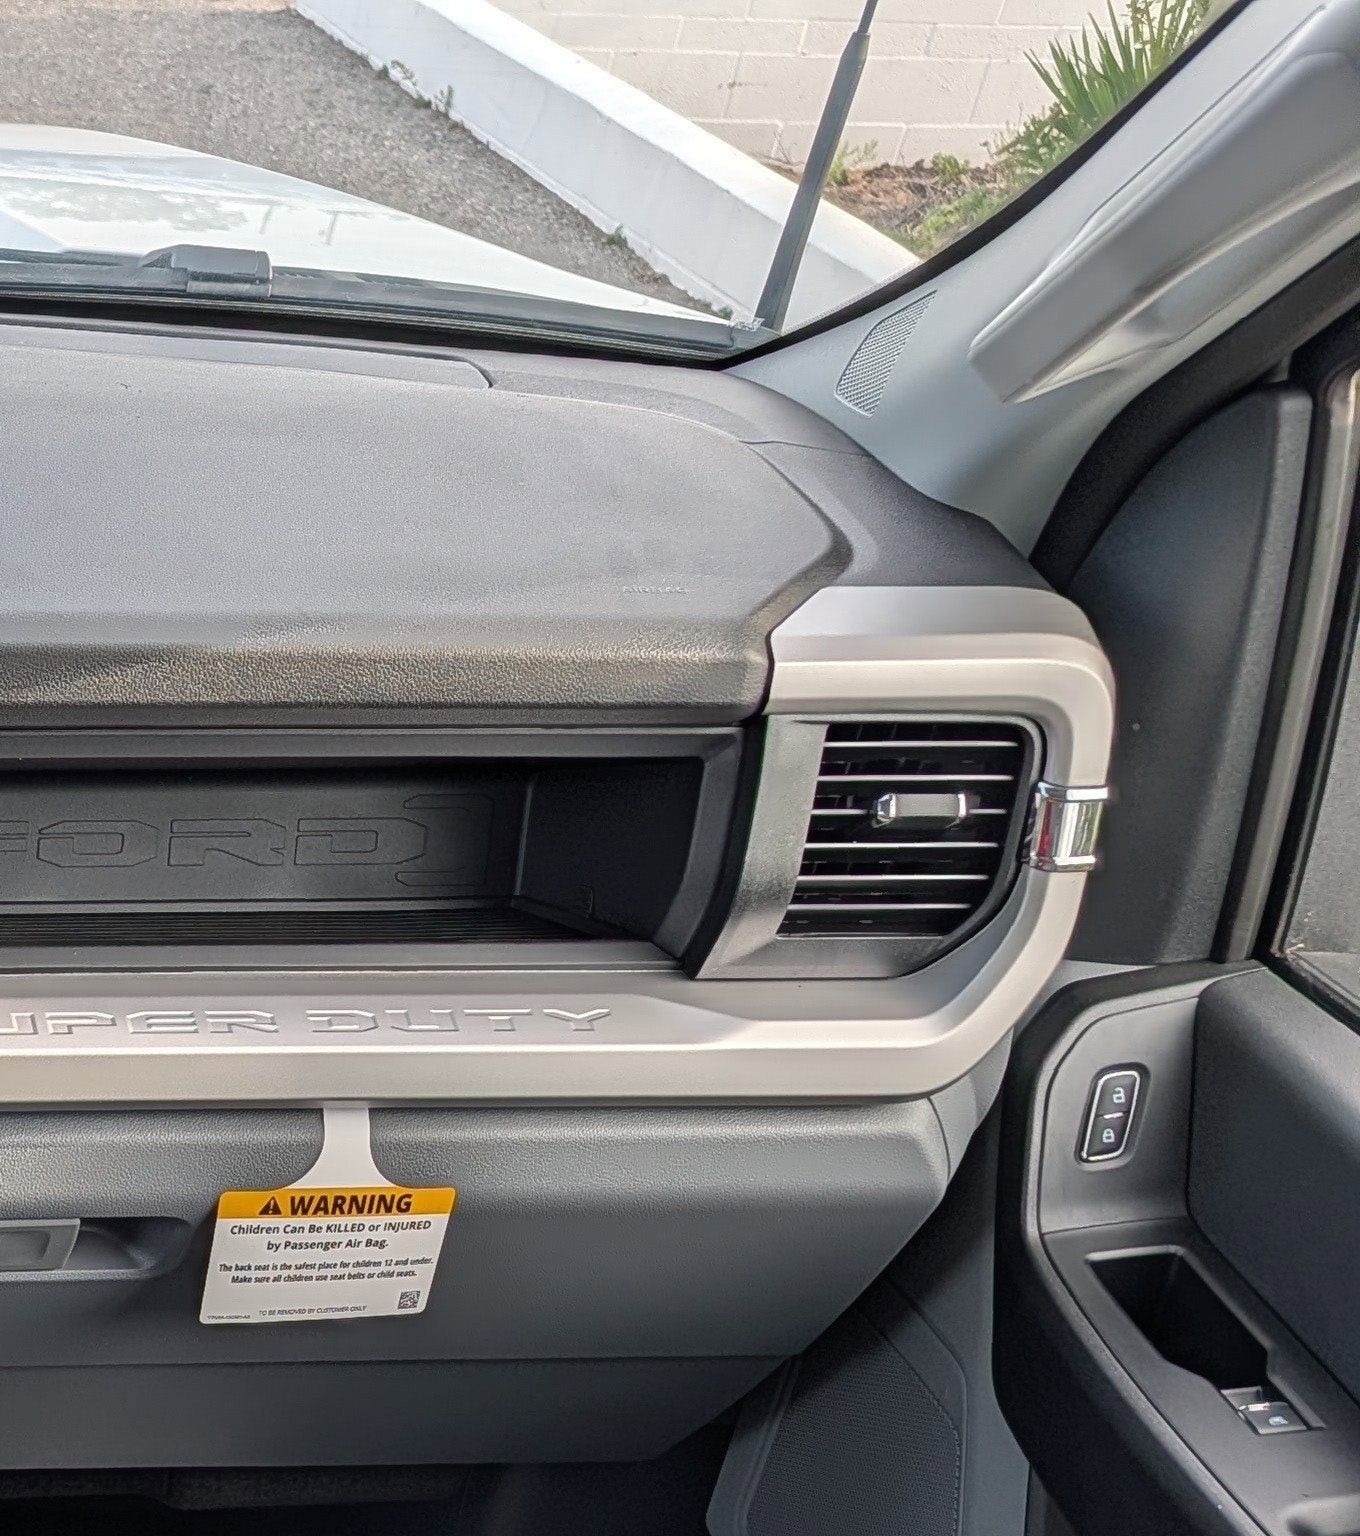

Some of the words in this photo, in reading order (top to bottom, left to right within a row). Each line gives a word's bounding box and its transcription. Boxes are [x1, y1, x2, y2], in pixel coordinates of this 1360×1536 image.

[308, 1006, 612, 1035] DUTY
[289, 1194, 413, 1215] WARNING
[230, 1225, 280, 1235] Children
[283, 1224, 305, 1234] Can
[308, 1224, 323, 1234] Be
[325, 1223, 365, 1233] KILLED
[368, 1224, 381, 1232] or
[384, 1221, 432, 1233] INJURED
[267, 1241, 282, 1252] by
[284, 1240, 343, 1251] Passenger
[345, 1239, 363, 1249] Air
[365, 1238, 389, 1249] Bag.
[219, 1264, 233, 1272] The
[272, 1263, 278, 1271] is
[280, 1263, 292, 1271] the
[294, 1262, 316, 1270] safest
[318, 1261, 338, 1271] place
[340, 1260, 350, 1269] for
[352, 1260, 382, 1268] children
[394, 1258, 409, 1266] and
[410, 1257, 433, 1265] under.
[272, 1274, 281, 1282] all
[283, 1274, 313, 1282] children
[347, 1272, 365, 1280] belts
